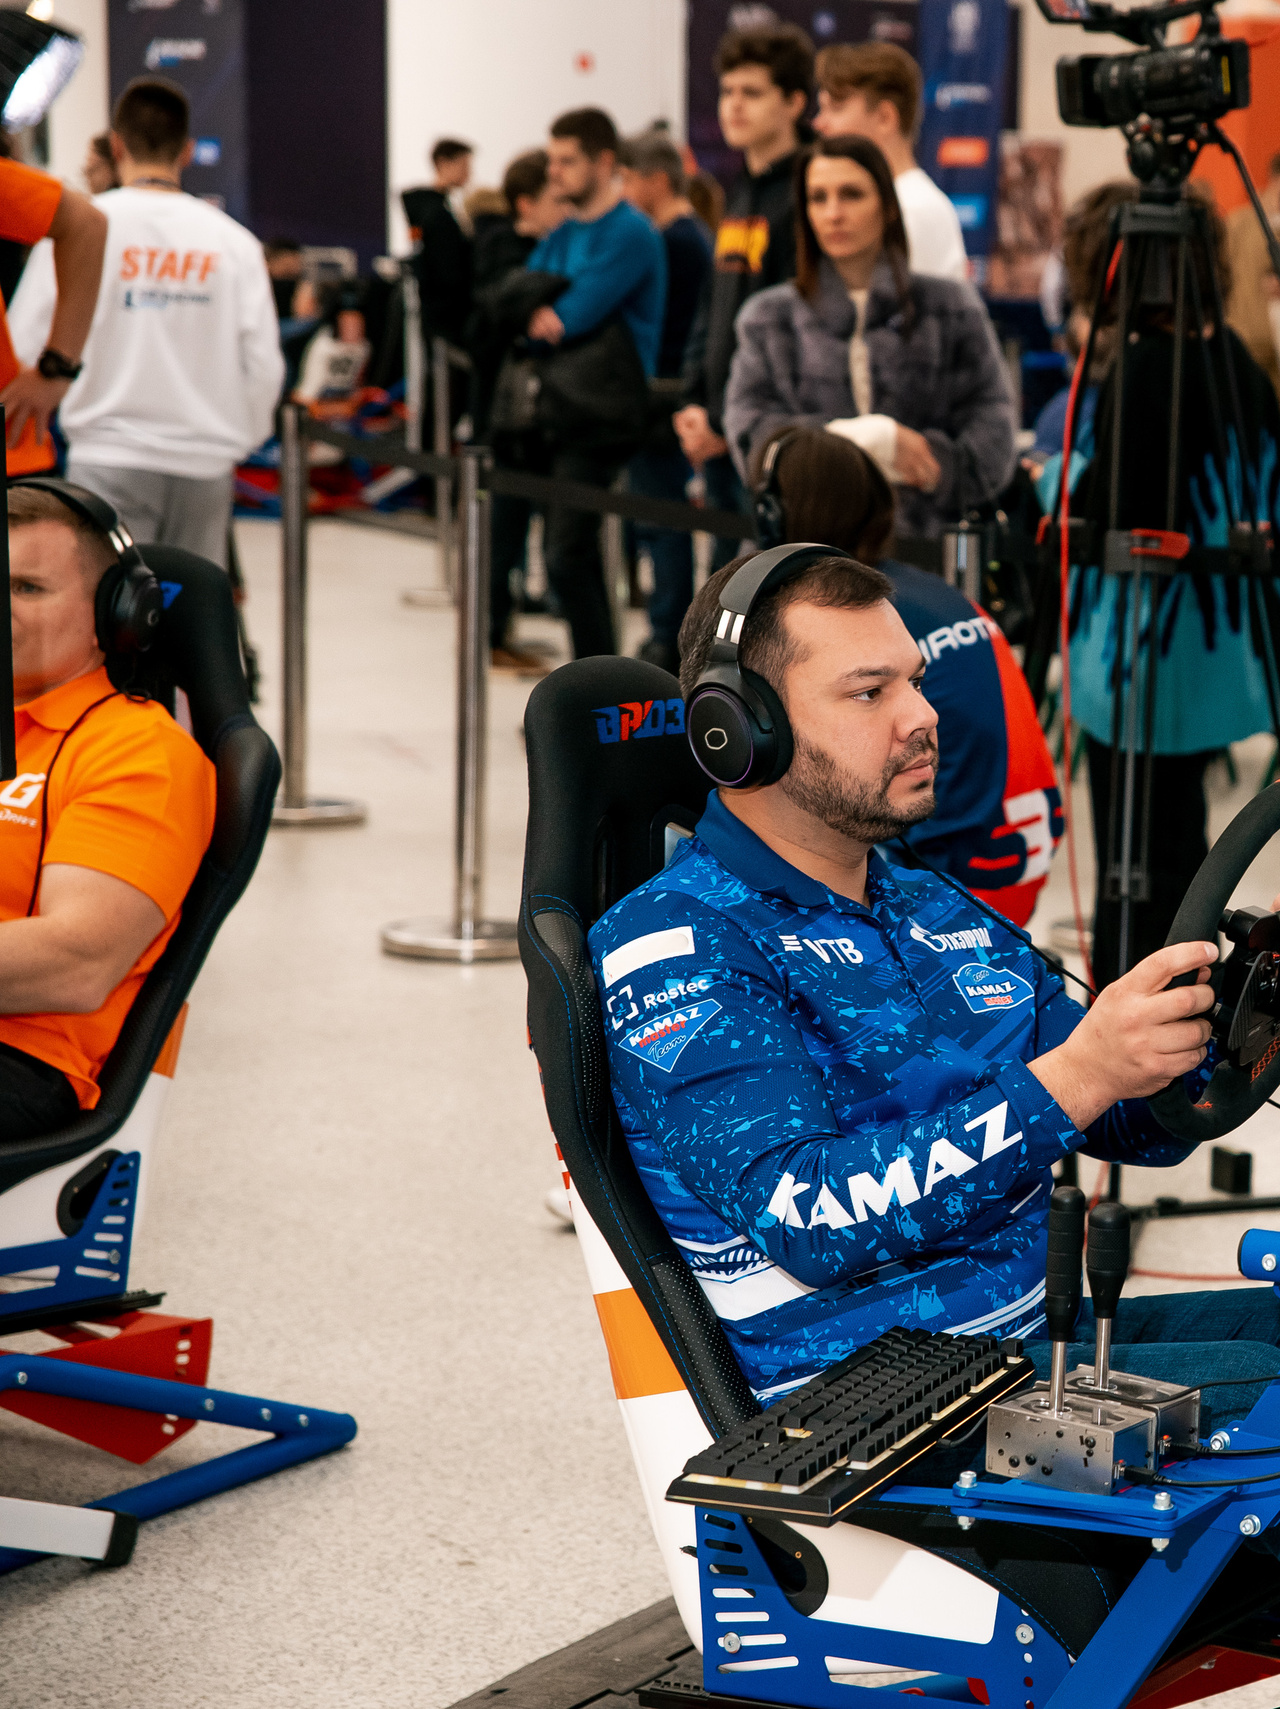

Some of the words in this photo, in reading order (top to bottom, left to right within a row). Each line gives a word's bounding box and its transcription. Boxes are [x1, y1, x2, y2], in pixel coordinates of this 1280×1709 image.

[120, 246, 219, 283] STAFF
[802, 937, 864, 964] VTB
[643, 979, 709, 1009] Rostec
[965, 980, 1017, 998] KAMAZ
[628, 1007, 702, 1048] KAMAZ
[638, 1019, 687, 1048] master
[647, 1034, 687, 1062] Team
[767, 1100, 1023, 1230] KAMAZ
